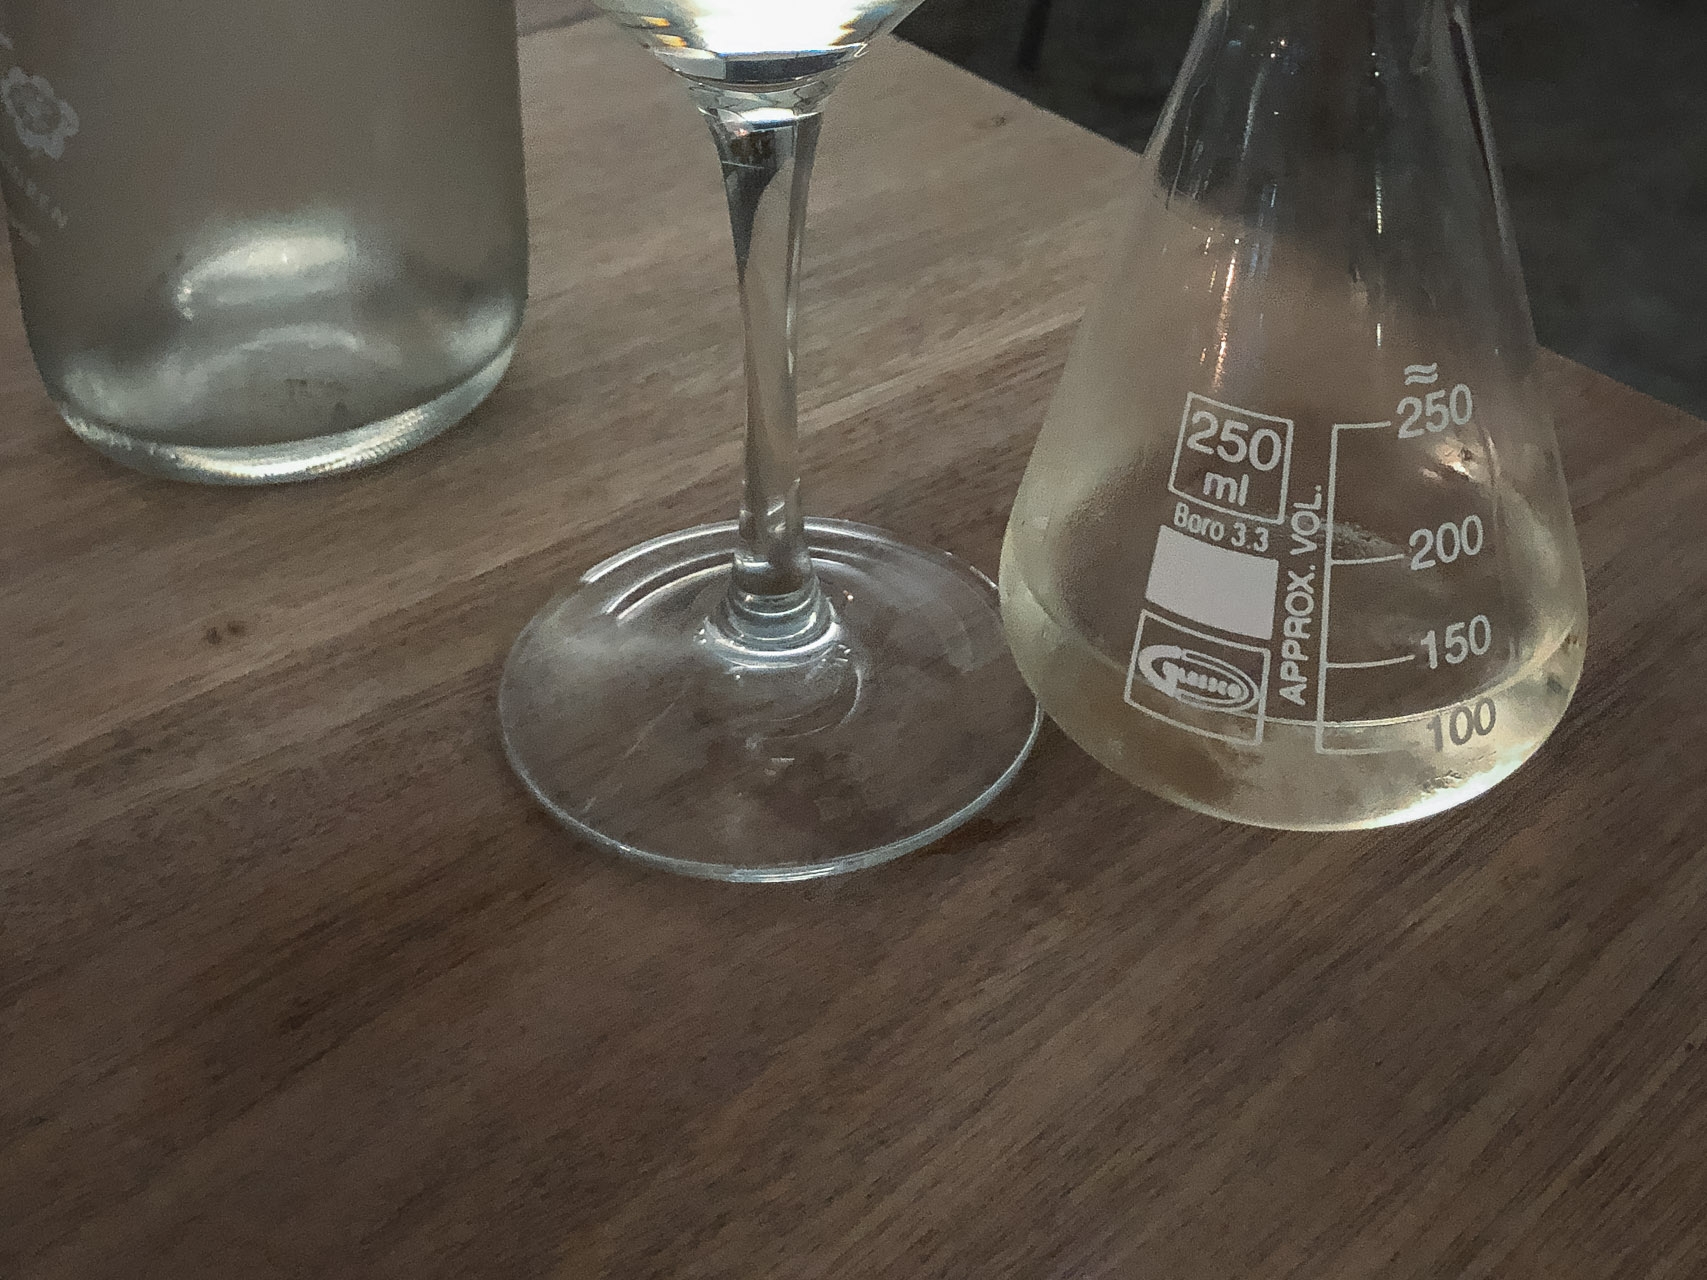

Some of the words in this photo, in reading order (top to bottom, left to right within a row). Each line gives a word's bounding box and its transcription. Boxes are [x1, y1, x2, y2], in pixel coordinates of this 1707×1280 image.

[1396, 383, 1473, 439] 250
[1186, 410, 1282, 471] 250
[1203, 471, 1250, 507] ml
[1173, 501, 1225, 541] Boro
[1230, 521, 1270, 552] 3.3
[1289, 484, 1323, 556] VOL.
[1408, 514, 1484, 570] 200
[1278, 564, 1316, 706] APPROX.
[1420, 614, 1492, 670] 150
[1426, 696, 1497, 753] 100
